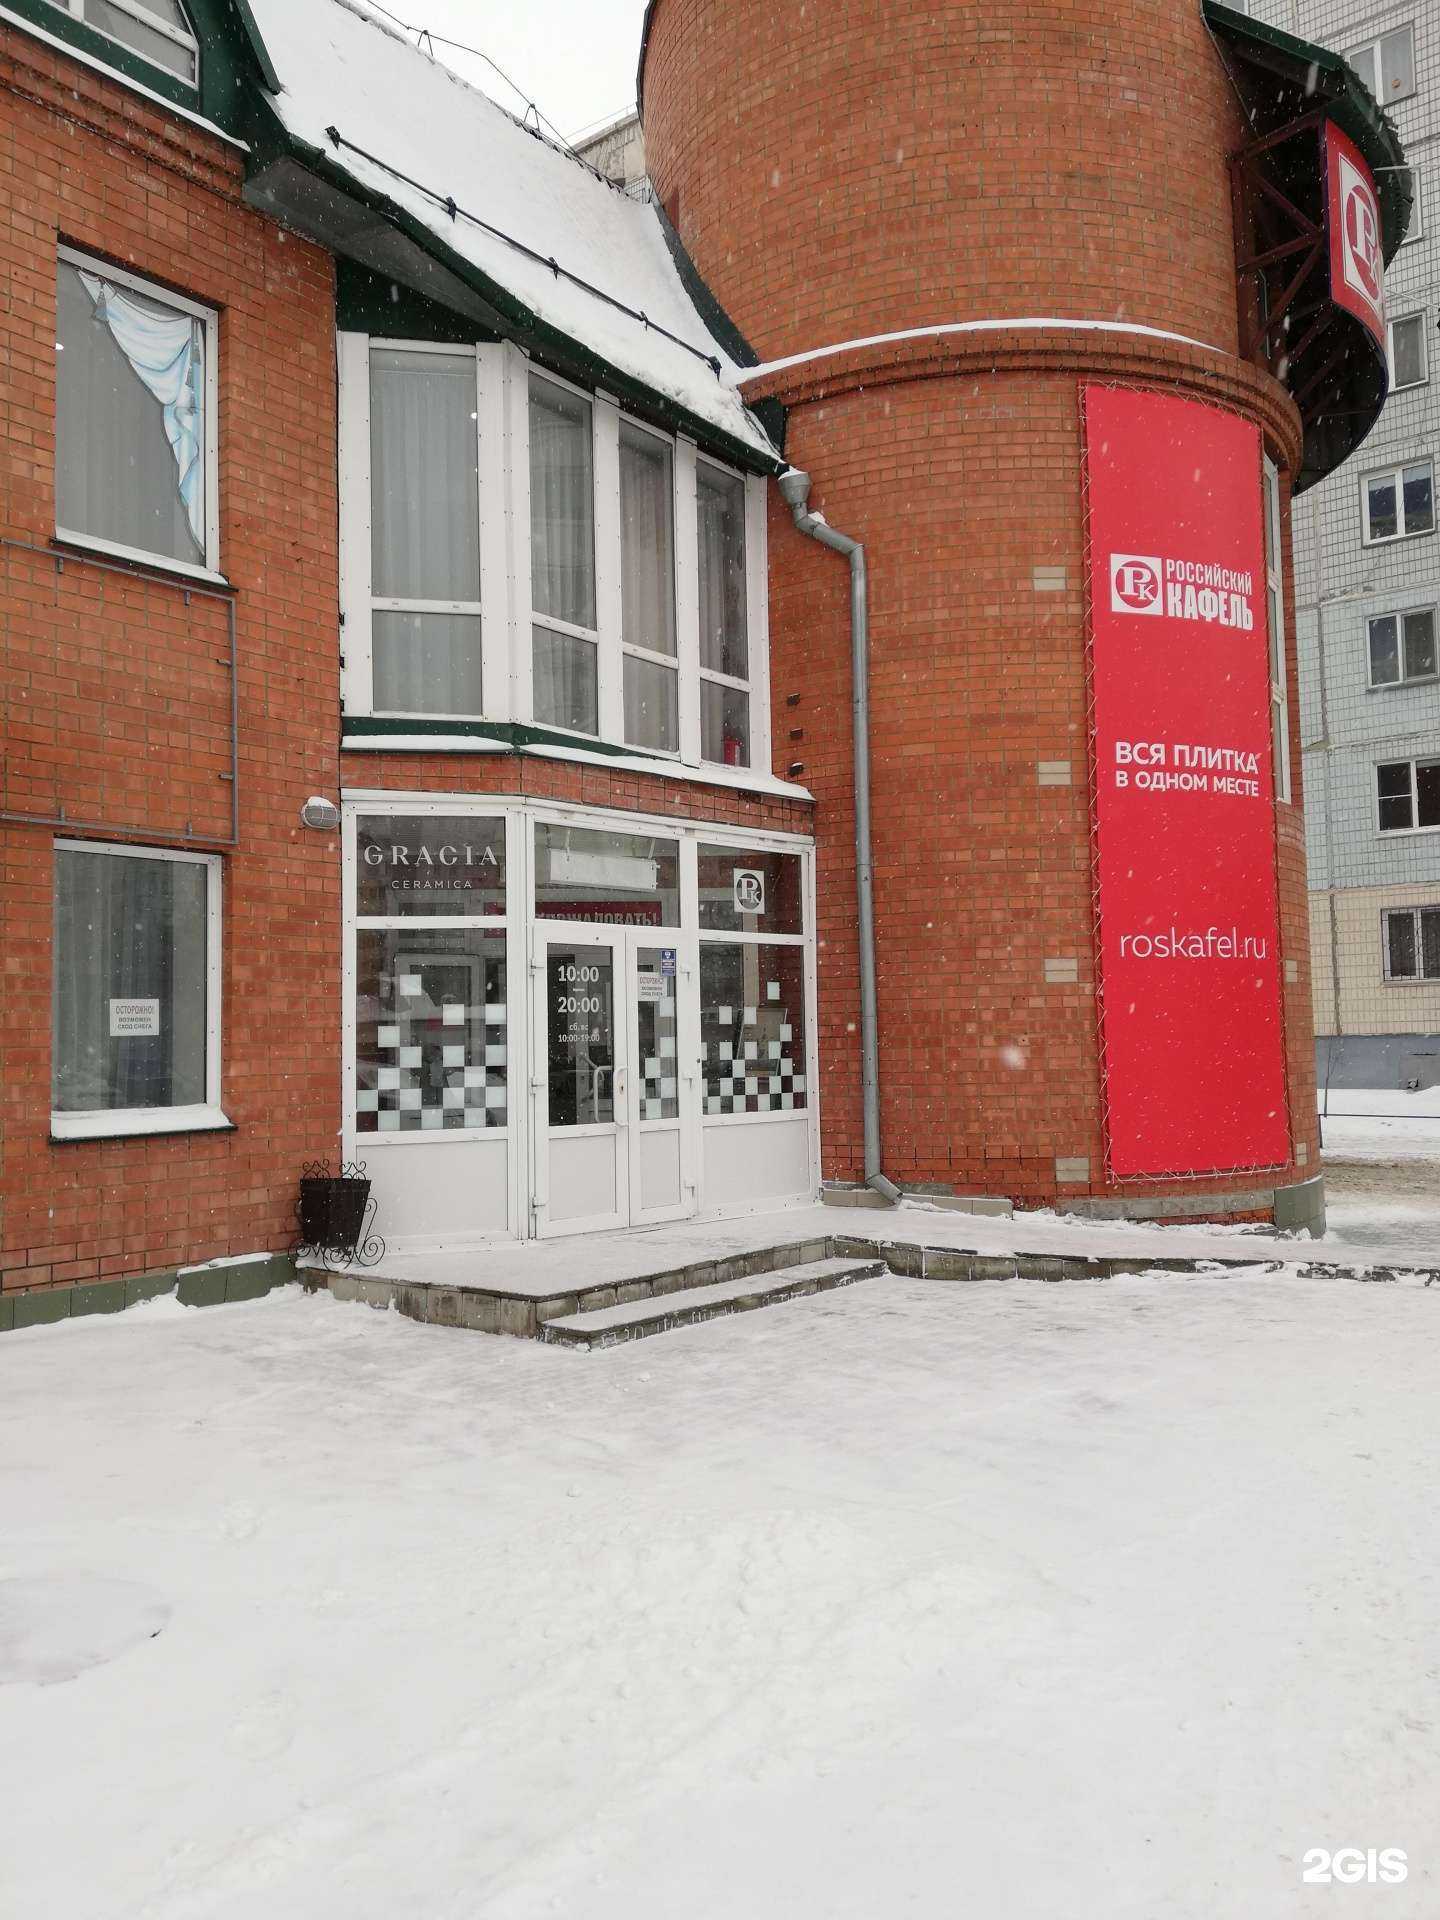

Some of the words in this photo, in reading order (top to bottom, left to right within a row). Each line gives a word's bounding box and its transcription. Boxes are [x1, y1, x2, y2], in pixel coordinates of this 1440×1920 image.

[1166, 558, 1252, 596] РОССИЙСКИЙ
[1167, 582, 1253, 631] КАФЕЛЬ
[1115, 741, 1166, 766] ВСЯ
[1173, 744, 1260, 775] ПЛИТКА
[1115, 770, 1129, 788] В
[1135, 771, 1208, 792] ОДНОМ
[1213, 776, 1260, 797] МЕСТЕ
[363, 844, 498, 867] GRACIA
[391, 880, 473, 889] CERAMICA
[1120, 926, 1267, 959] roskafel.ru
[558, 965, 600, 982] 10:00
[558, 996, 600, 1014] 20:00
